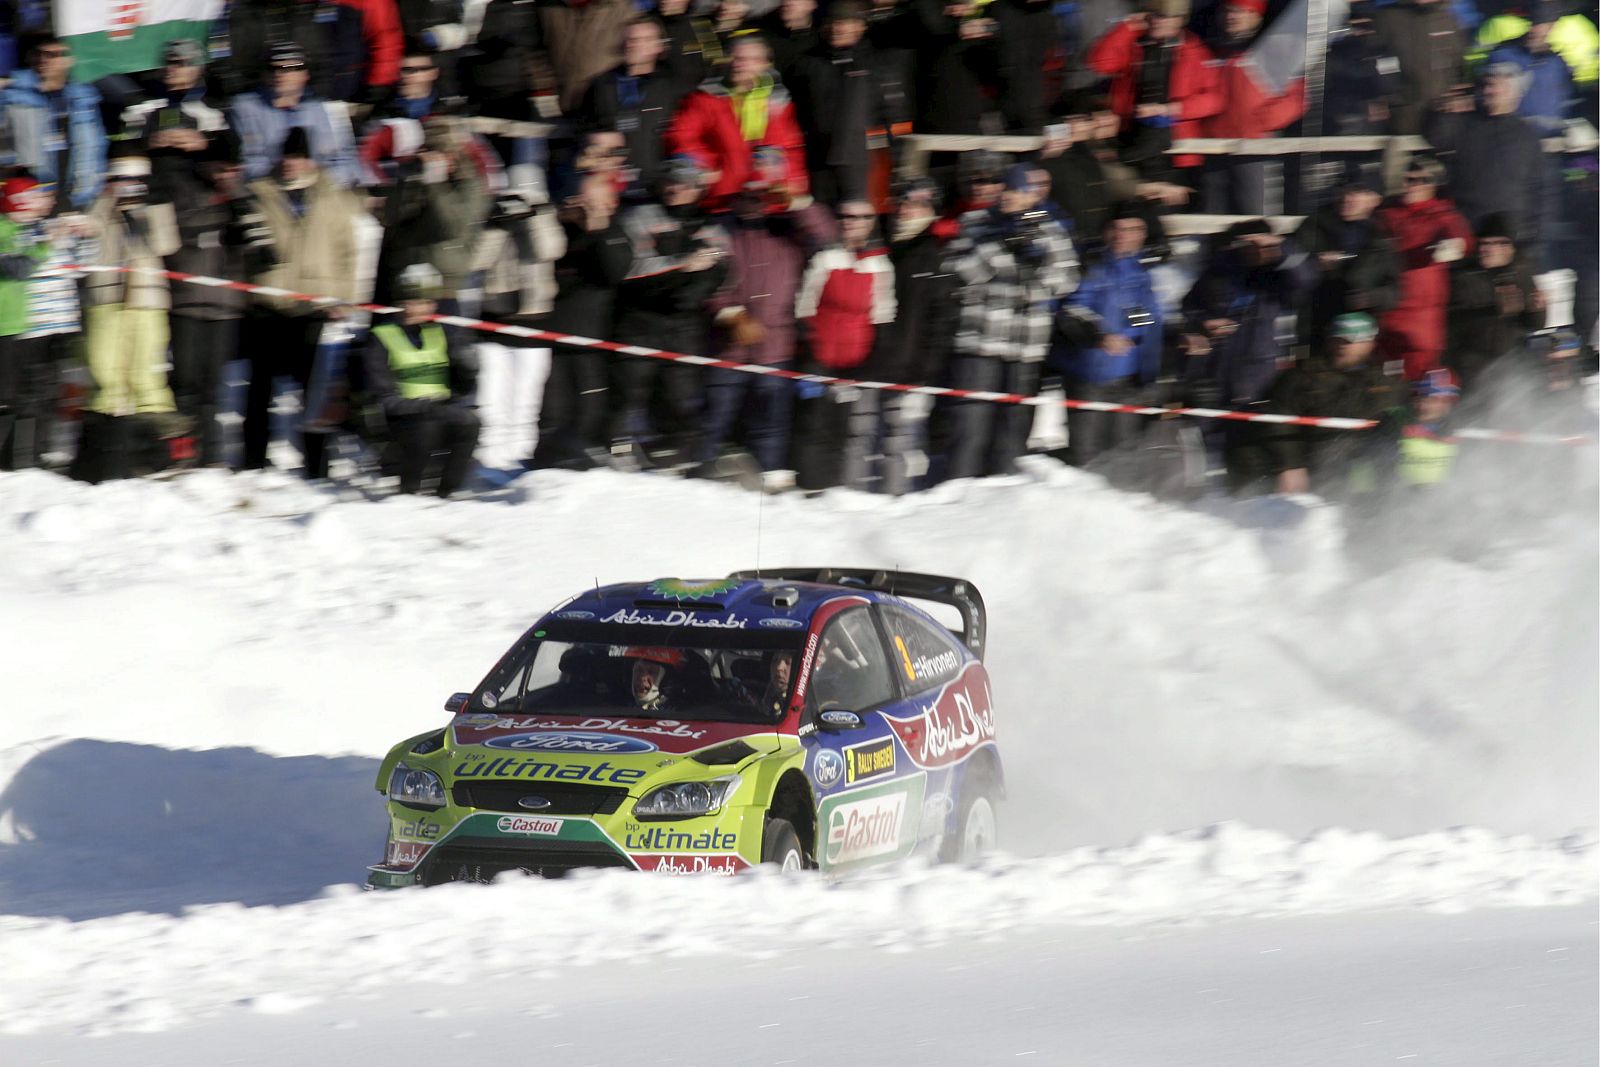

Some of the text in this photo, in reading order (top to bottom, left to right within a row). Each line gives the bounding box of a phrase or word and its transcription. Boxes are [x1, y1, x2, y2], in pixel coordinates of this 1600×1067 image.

[600, 608, 748, 629] Abu Dhabi
[895, 635, 916, 681] 3
[917, 650, 958, 680] Hirvonen
[474, 717, 706, 739] Abu Dhabi
[824, 711, 857, 723] Ford
[511, 733, 626, 751] Ford
[920, 700, 957, 763] Abu
[454, 757, 646, 785] ultimate
[818, 755, 838, 782] Ford
[847, 744, 894, 783] 3 RALLY SWEDEN
[399, 817, 440, 839] ate
[512, 818, 558, 833] Castrol
[625, 822, 640, 833] bp
[844, 800, 901, 850] Castrol
[626, 827, 737, 850] ultimate
[653, 856, 736, 876] Abu Dhabi
